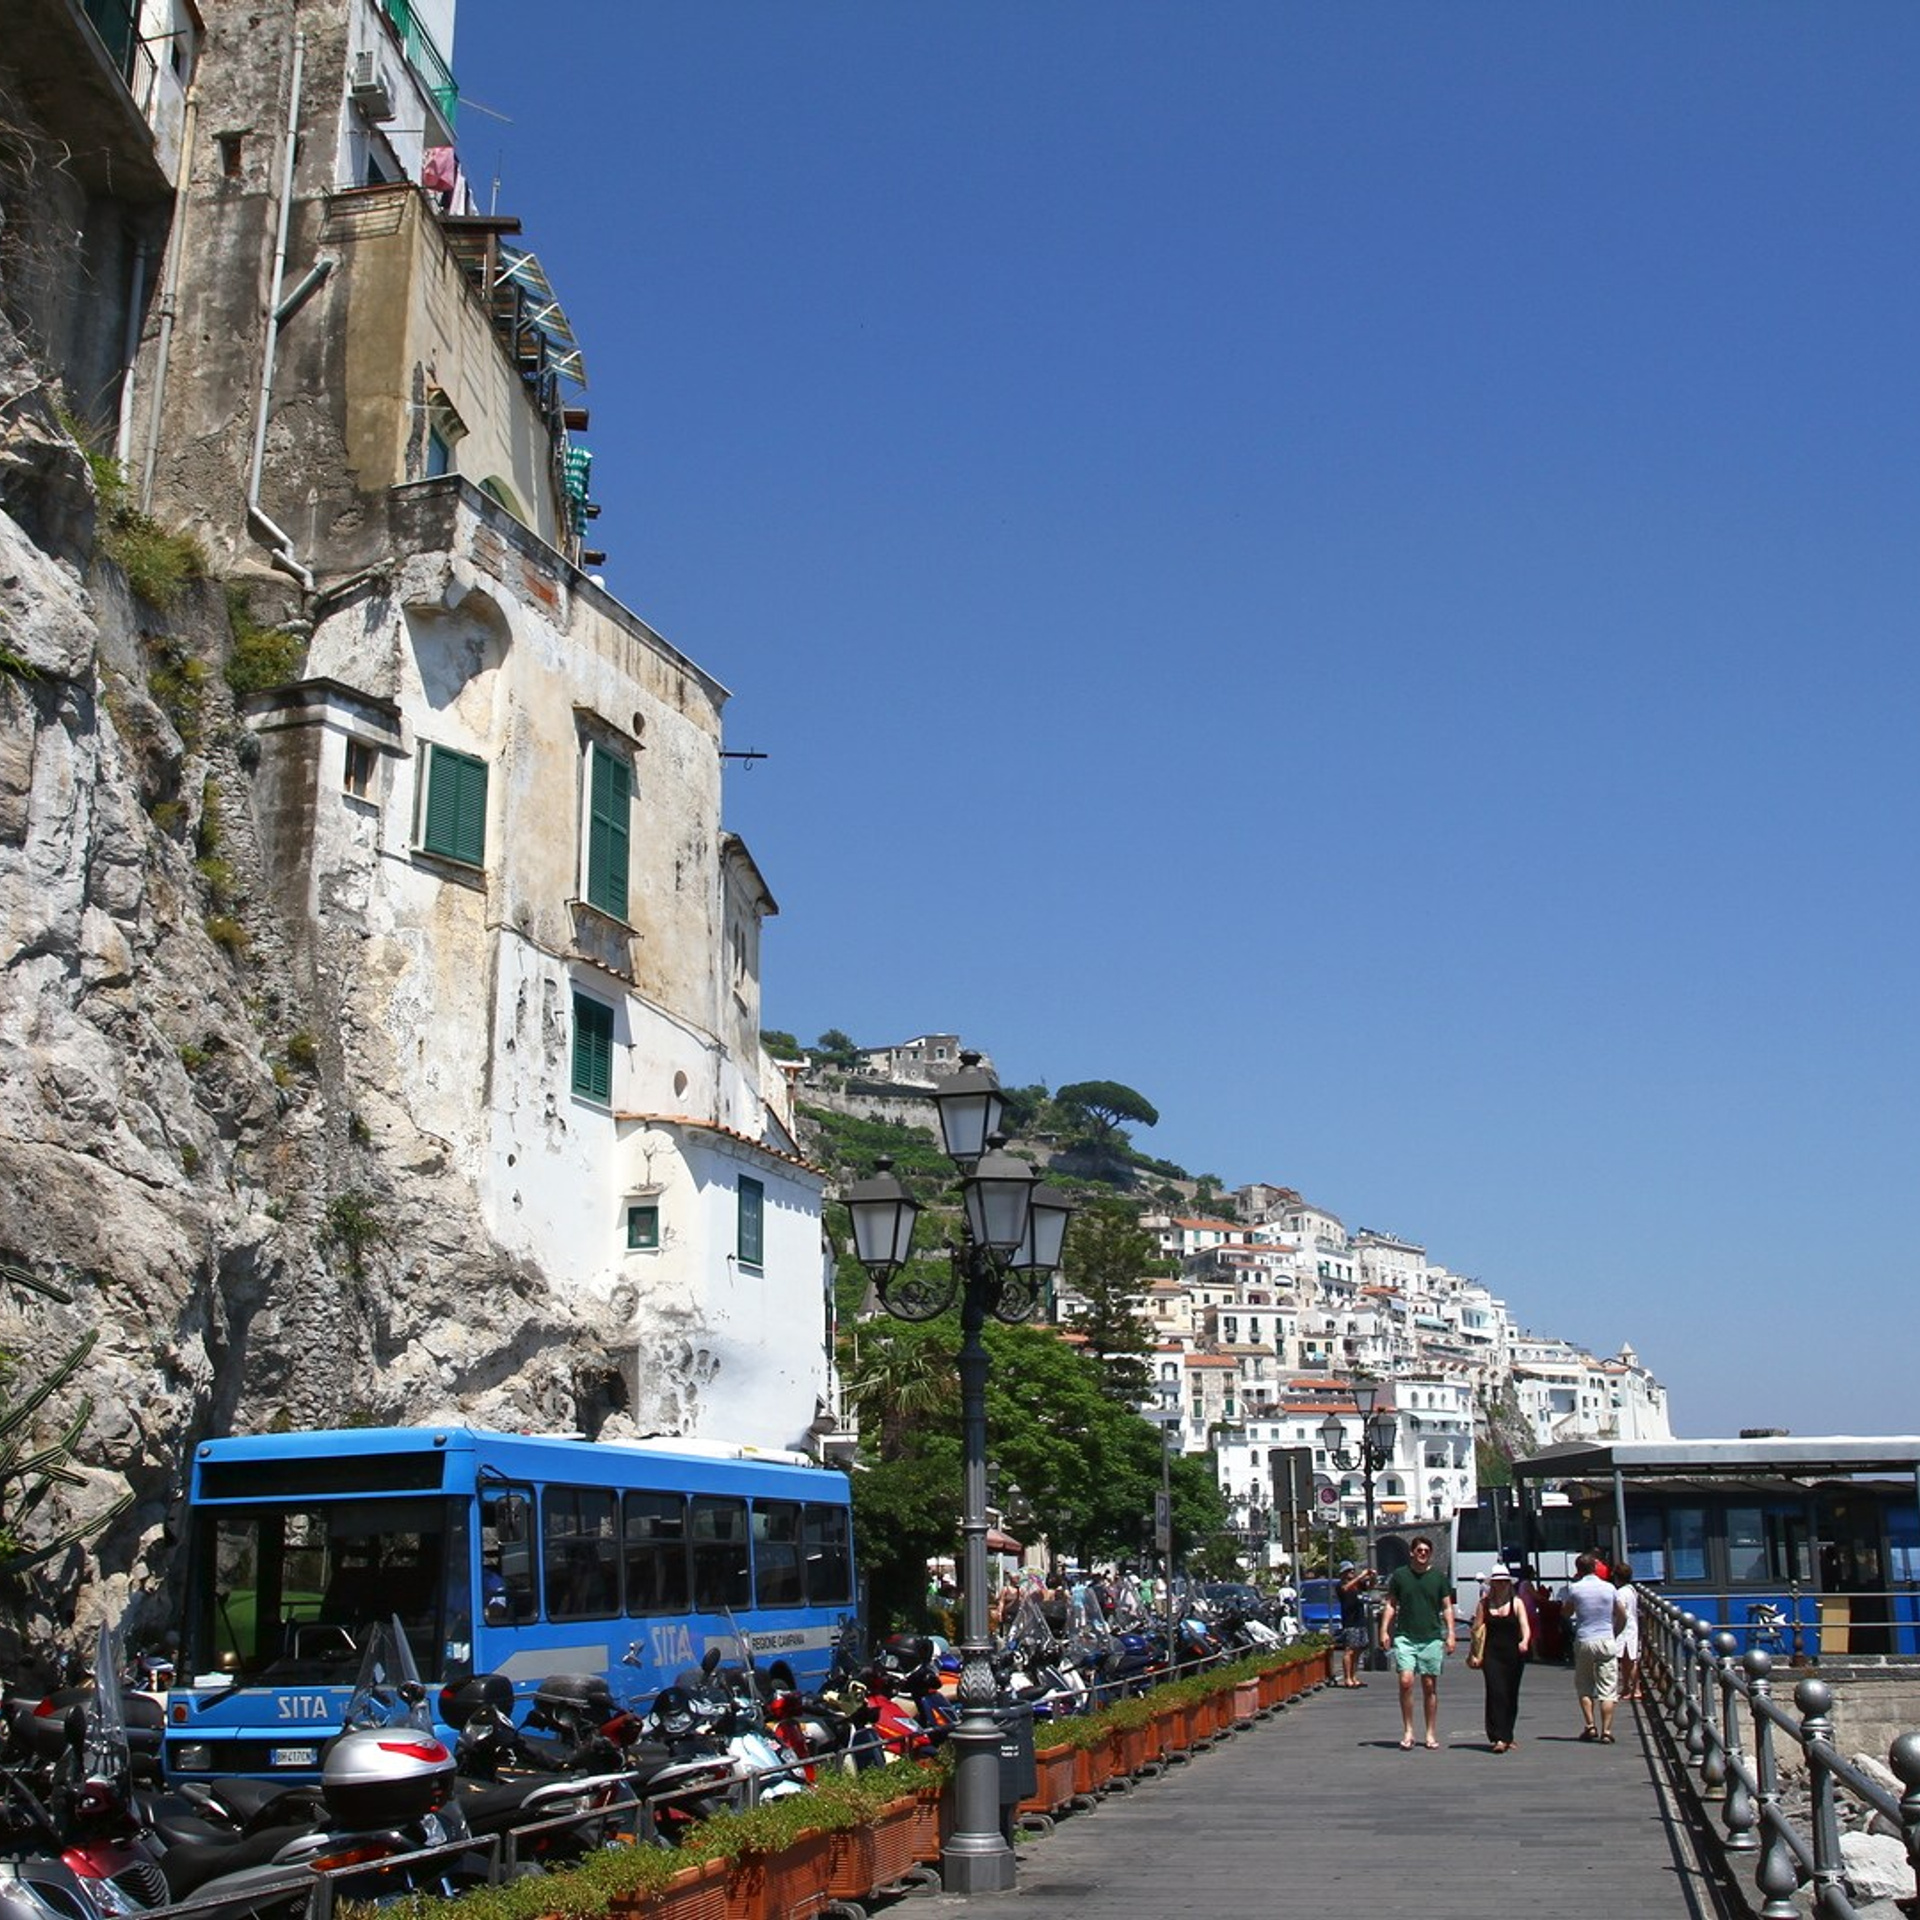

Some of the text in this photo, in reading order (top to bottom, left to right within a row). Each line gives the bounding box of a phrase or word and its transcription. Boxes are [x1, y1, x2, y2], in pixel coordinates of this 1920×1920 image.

[652, 1624, 696, 1667] SITA
[752, 1633, 804, 1650] REGIONE CAMPANIA
[278, 1695, 328, 1719] SITA
